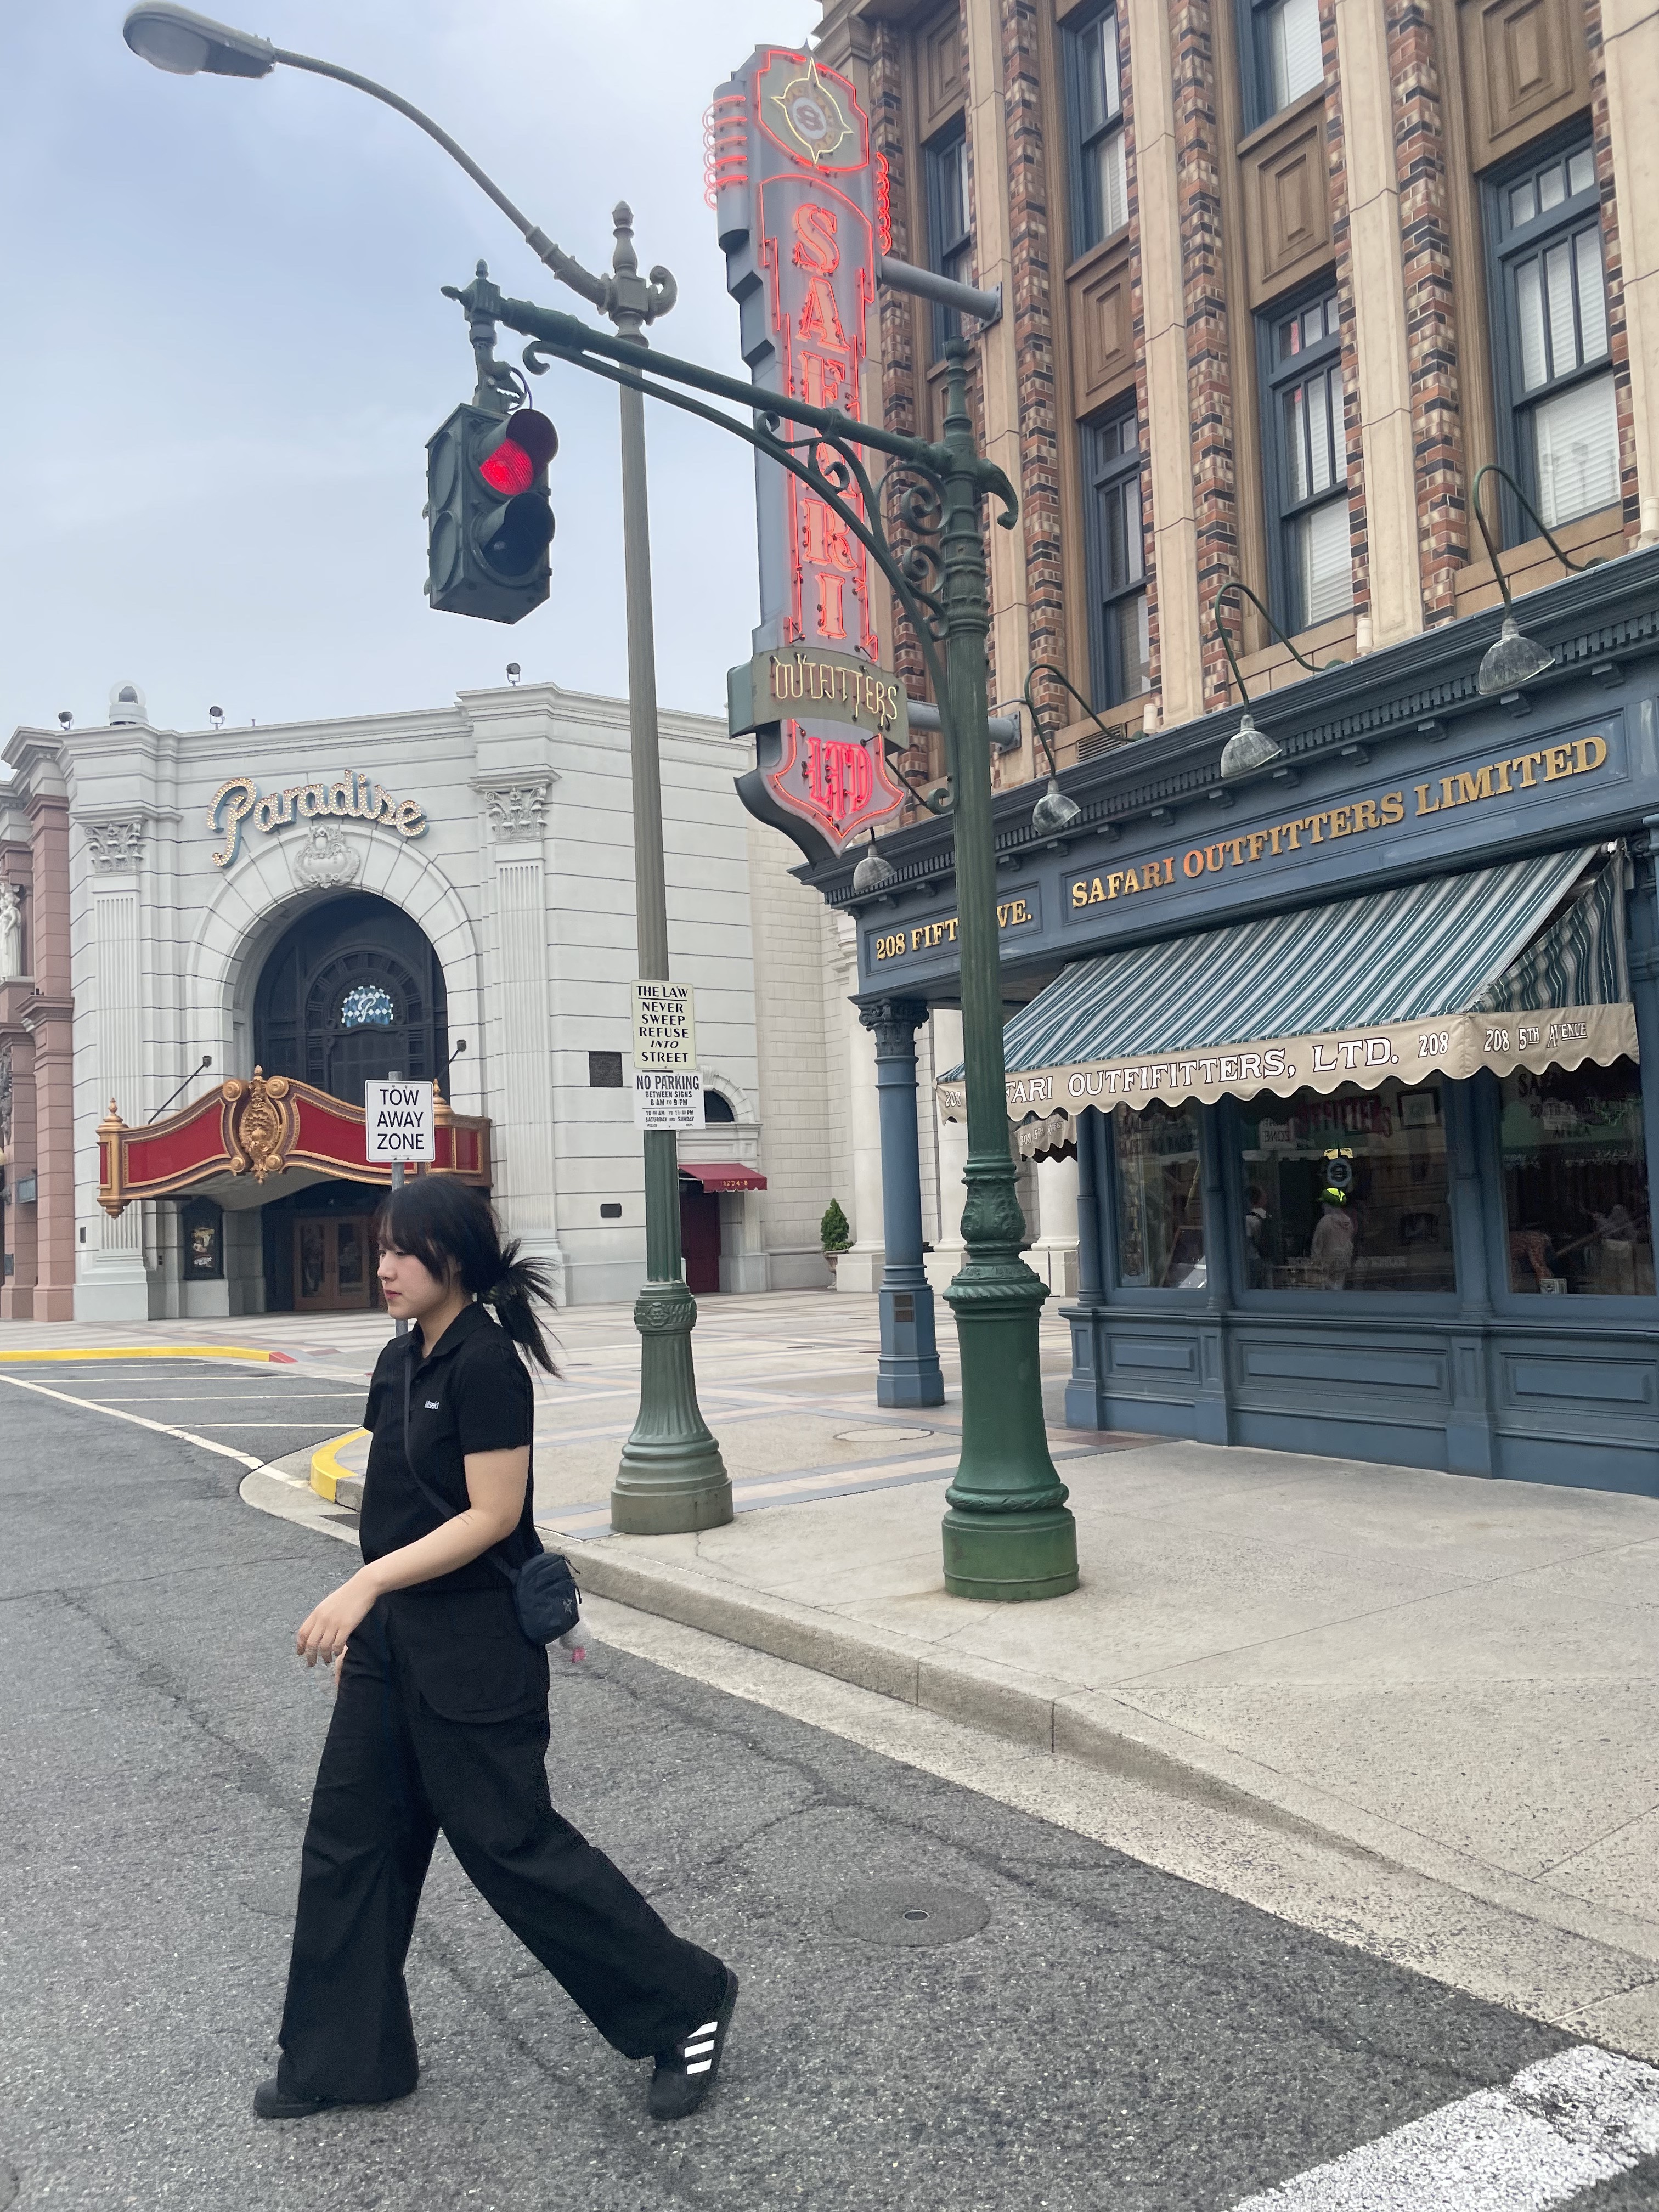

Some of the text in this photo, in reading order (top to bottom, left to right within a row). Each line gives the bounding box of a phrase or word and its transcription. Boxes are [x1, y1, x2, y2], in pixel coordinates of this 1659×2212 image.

[771, 662, 898, 720] OUTFITTERS
[806, 737, 873, 821] LTD
[207, 769, 427, 867] Paradise
[1072, 736, 1607, 908] SAFARI OUTFITTERS LIMITED
[876, 899, 1032, 960] 208 FIFT VE.
[636, 986, 689, 998] THE LAW
[642, 1001, 684, 1013] NEVER
[641, 1014, 685, 1025] SWEEP
[639, 1026, 689, 1038] REFUSE
[1483, 1022, 1588, 1052] 208 5TH AVENUE
[651, 1040, 679, 1048] INTO
[1418, 1030, 1449, 1058] 208
[641, 1052, 689, 1063] STREET
[1005, 1036, 1399, 1104] FARI OUTFIFITTERS, LTD.
[636, 1075, 699, 1091] NO PARKING
[380, 1089, 419, 1105] TOW
[945, 1091, 962, 1108] 208
[377, 1111, 424, 1127] AWAY
[377, 1133, 424, 1149] ZONE
